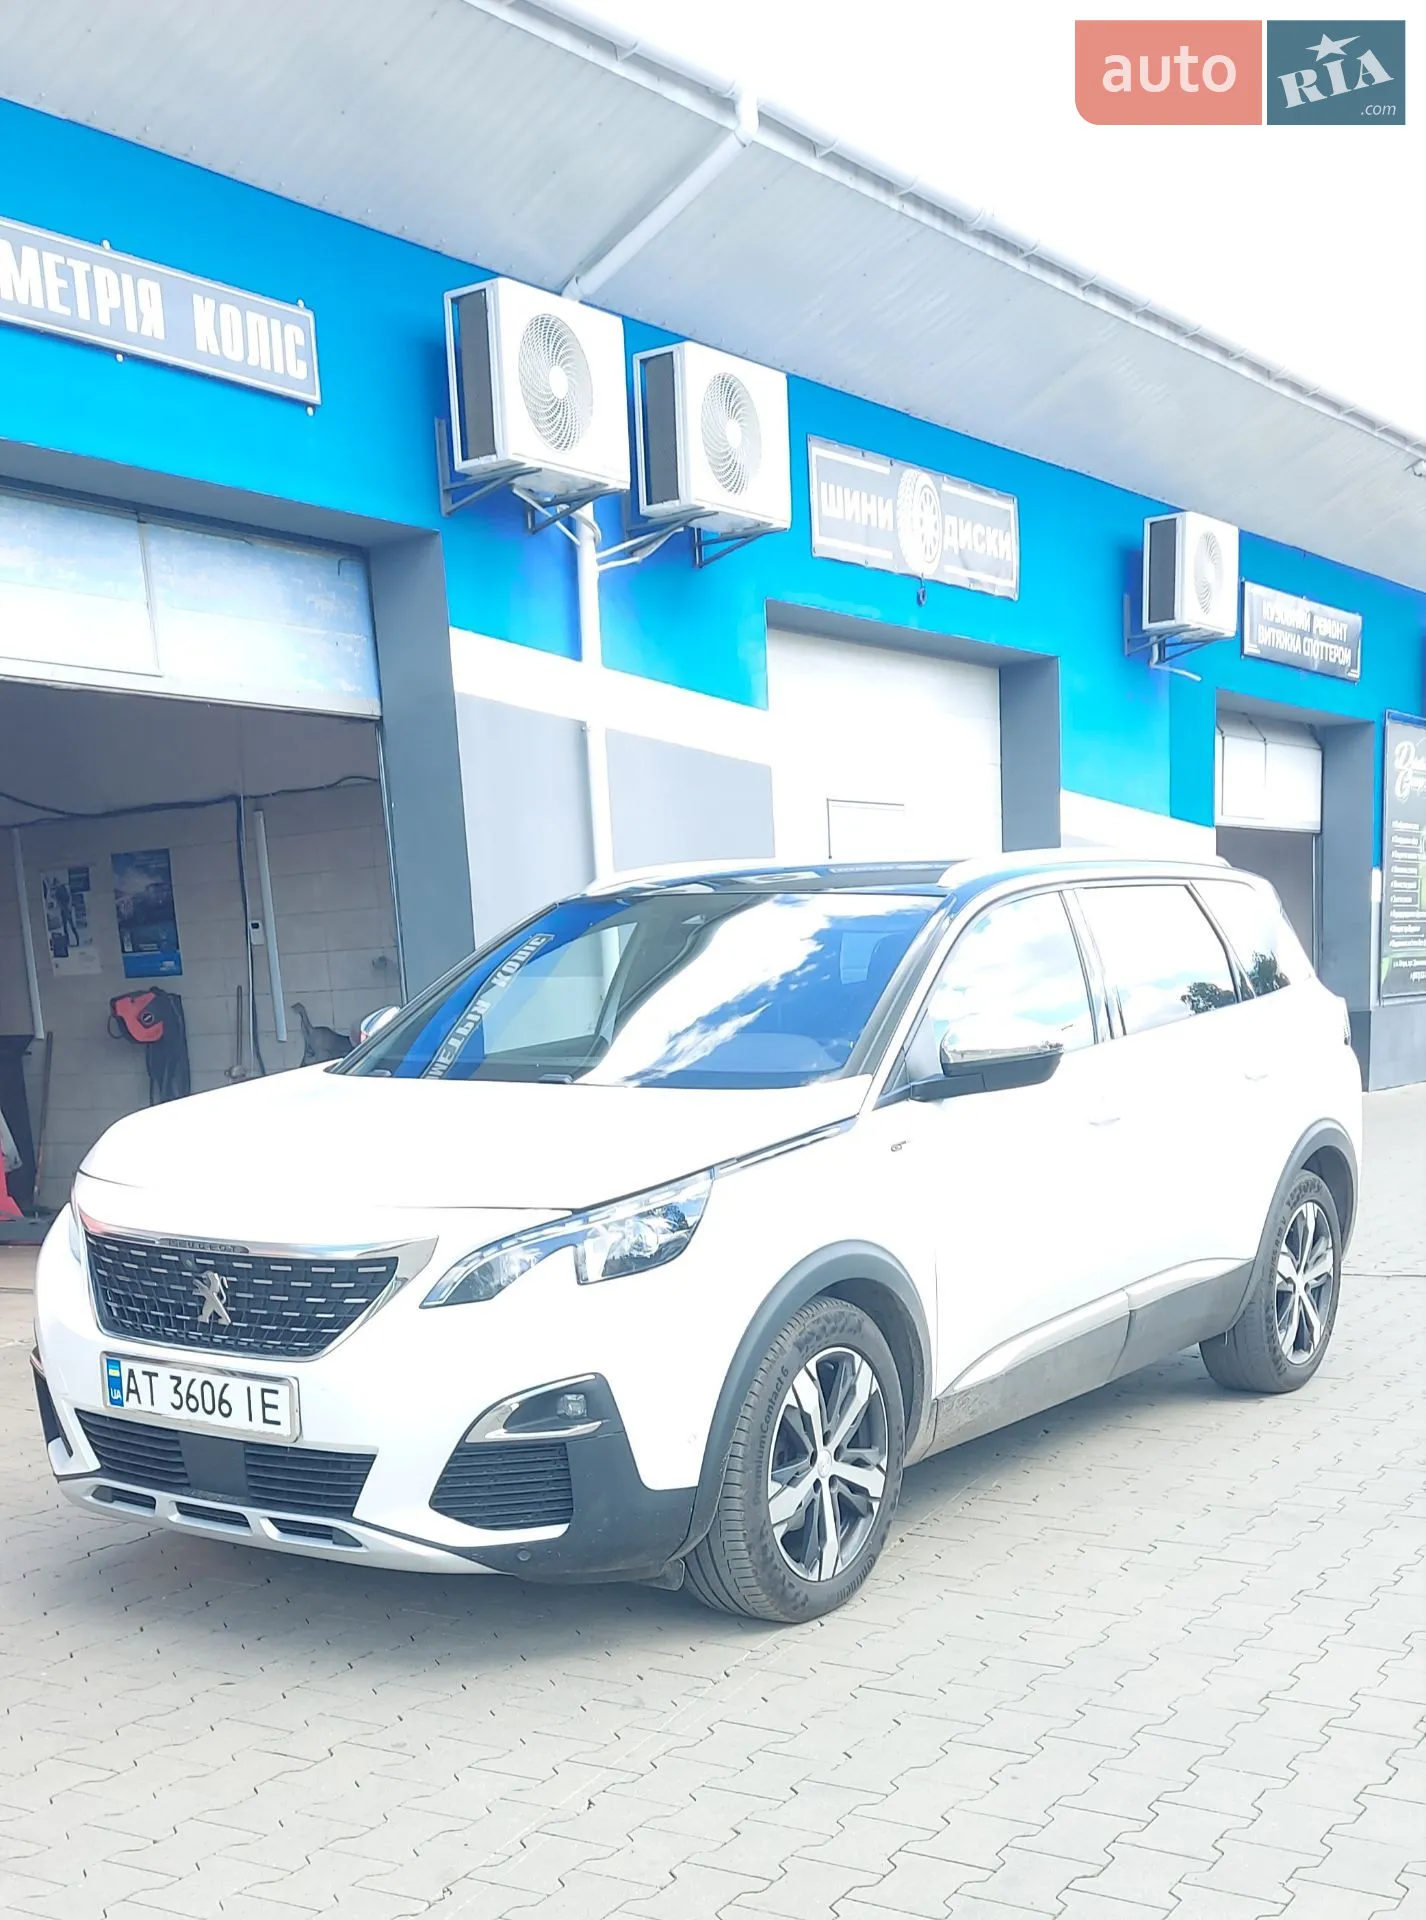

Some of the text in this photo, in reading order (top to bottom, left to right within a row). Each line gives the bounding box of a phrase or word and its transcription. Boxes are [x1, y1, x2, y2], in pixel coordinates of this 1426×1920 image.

[193, 293, 309, 381] КОЛІС
[821, 482, 1012, 562] ШИНИ ДИСКИ
[1258, 624, 1352, 667] ВИТЯЖКА СПОТТЕРОМ
[110, 1388, 123, 1400] UA
[781, 1365, 789, 1377] 6
[126, 1368, 281, 1426] AT 3606 IE
